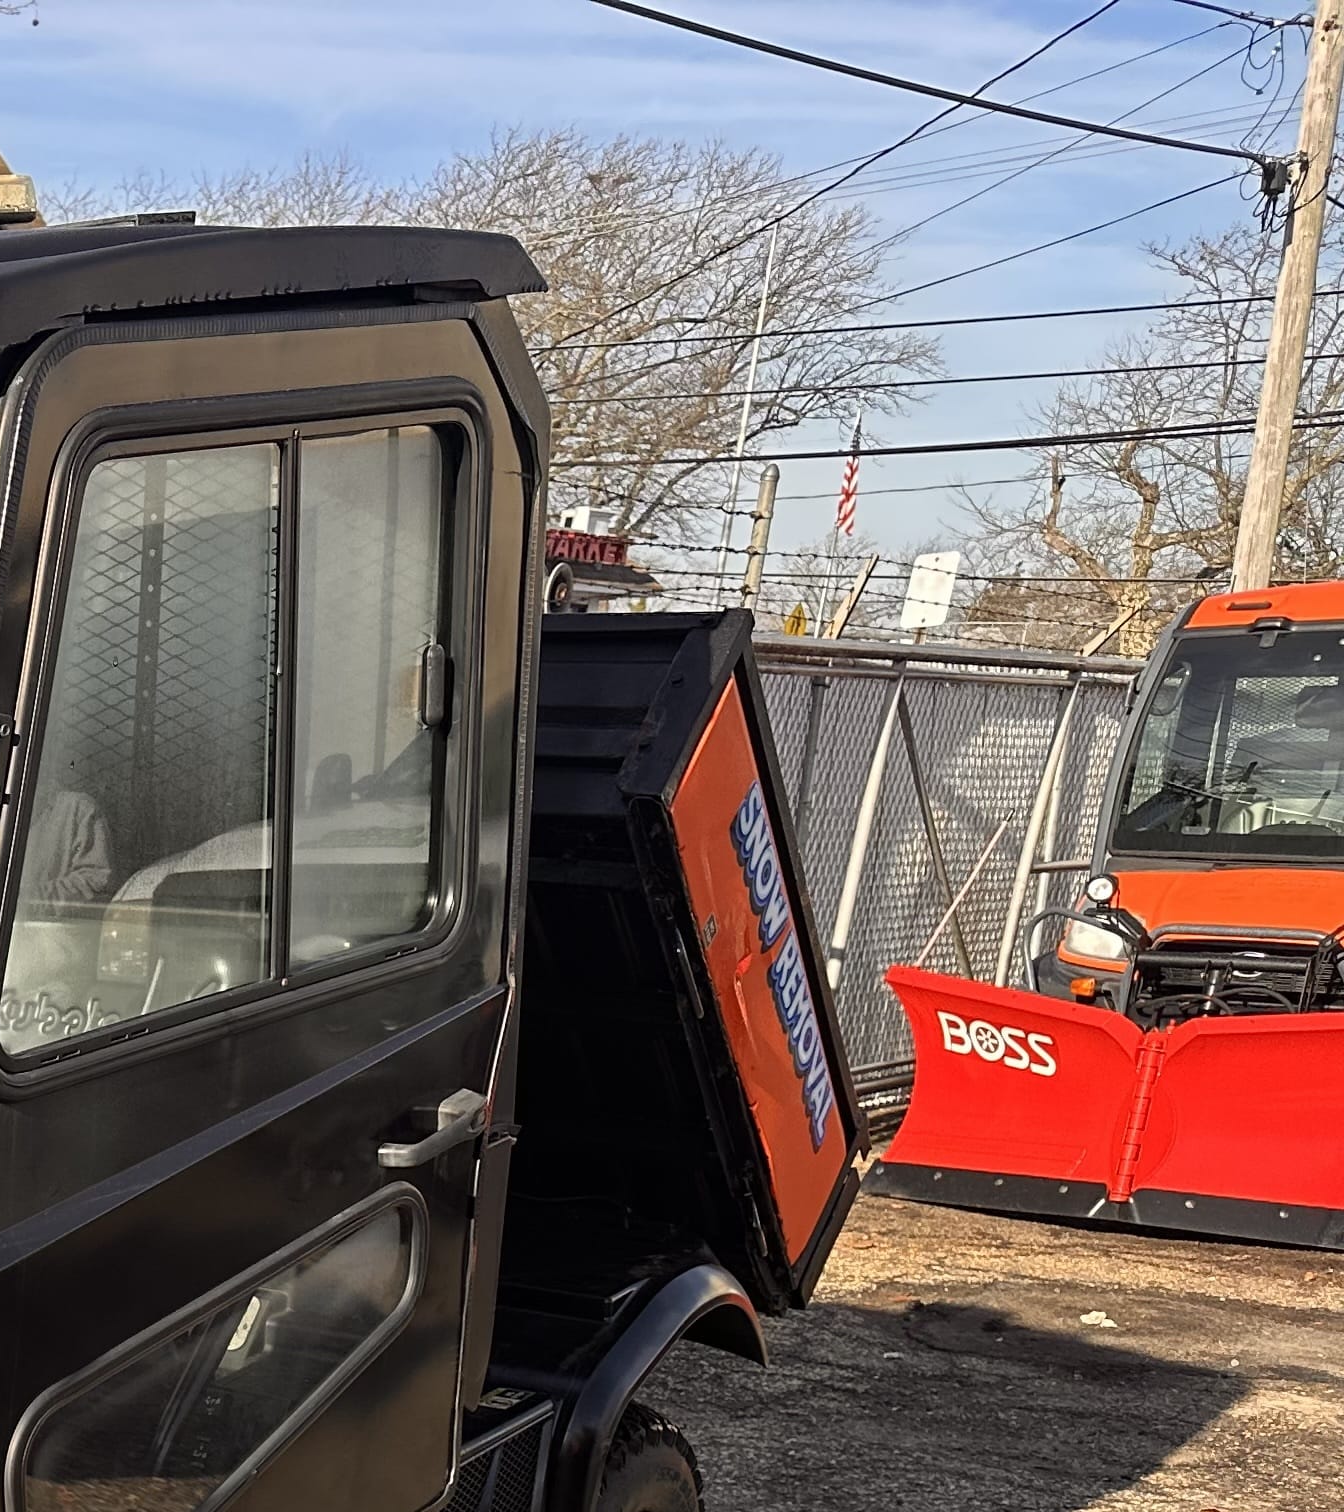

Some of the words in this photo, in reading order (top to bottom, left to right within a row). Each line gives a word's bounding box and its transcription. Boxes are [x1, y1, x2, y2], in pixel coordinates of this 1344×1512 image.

[734, 782, 792, 950] SNOW
[770, 932, 835, 1151] REMOVAL
[936, 1010, 1057, 1077] BOSS
